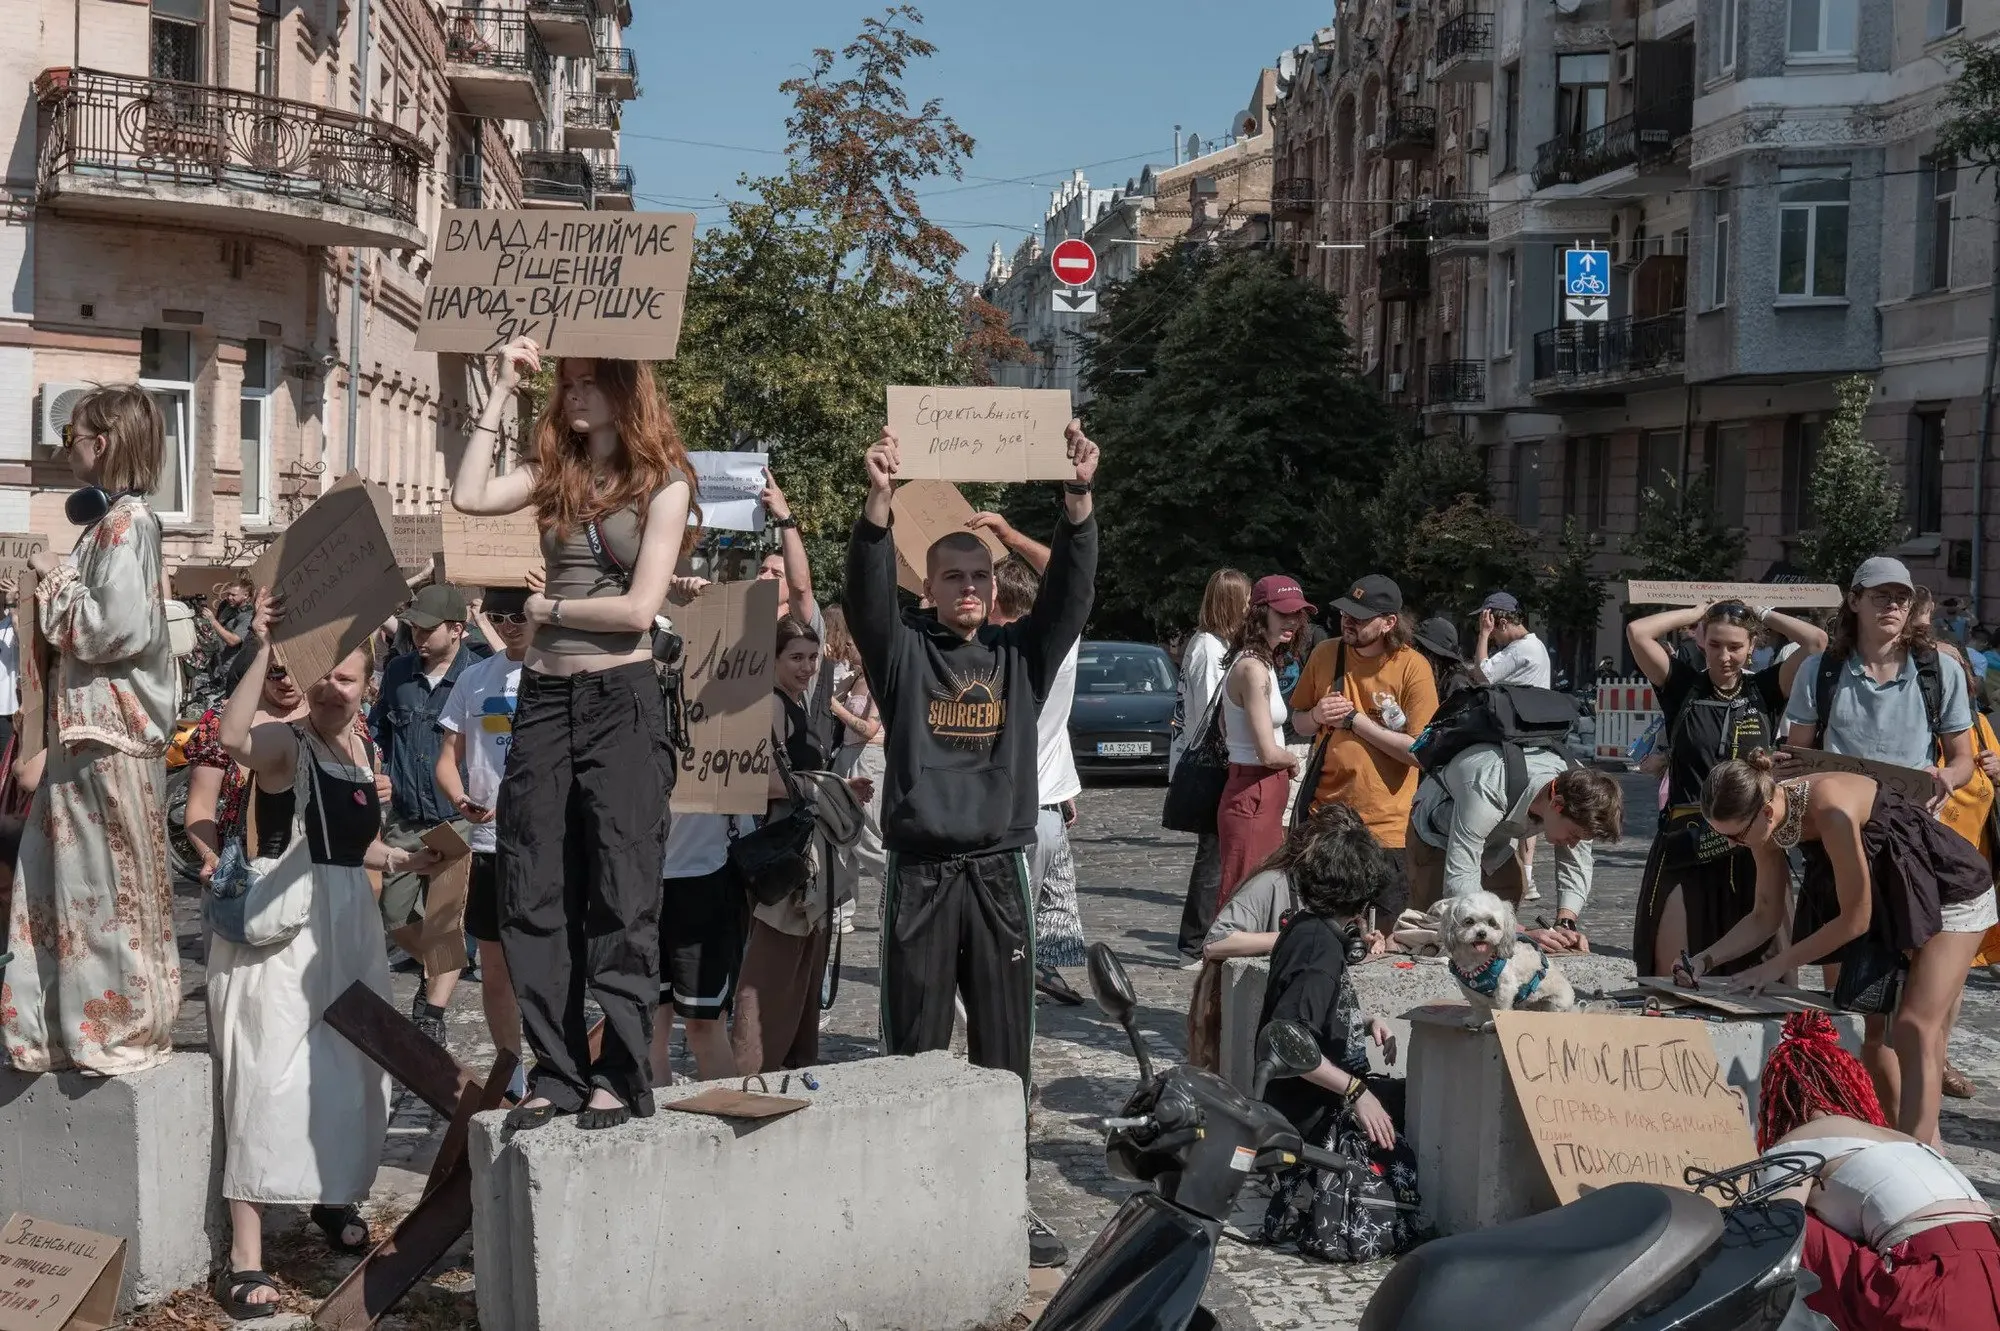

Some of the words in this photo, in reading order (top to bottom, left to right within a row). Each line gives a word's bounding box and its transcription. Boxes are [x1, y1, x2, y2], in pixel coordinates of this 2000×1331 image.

[493, 253, 623, 287] РІШЕННЯ
[588, 520, 602, 553] Cano
[682, 738, 769, 787] едорова
[1103, 743, 1115, 752] AA
[1117, 743, 1135, 752] 3252
[1138, 743, 1148, 752] YE
